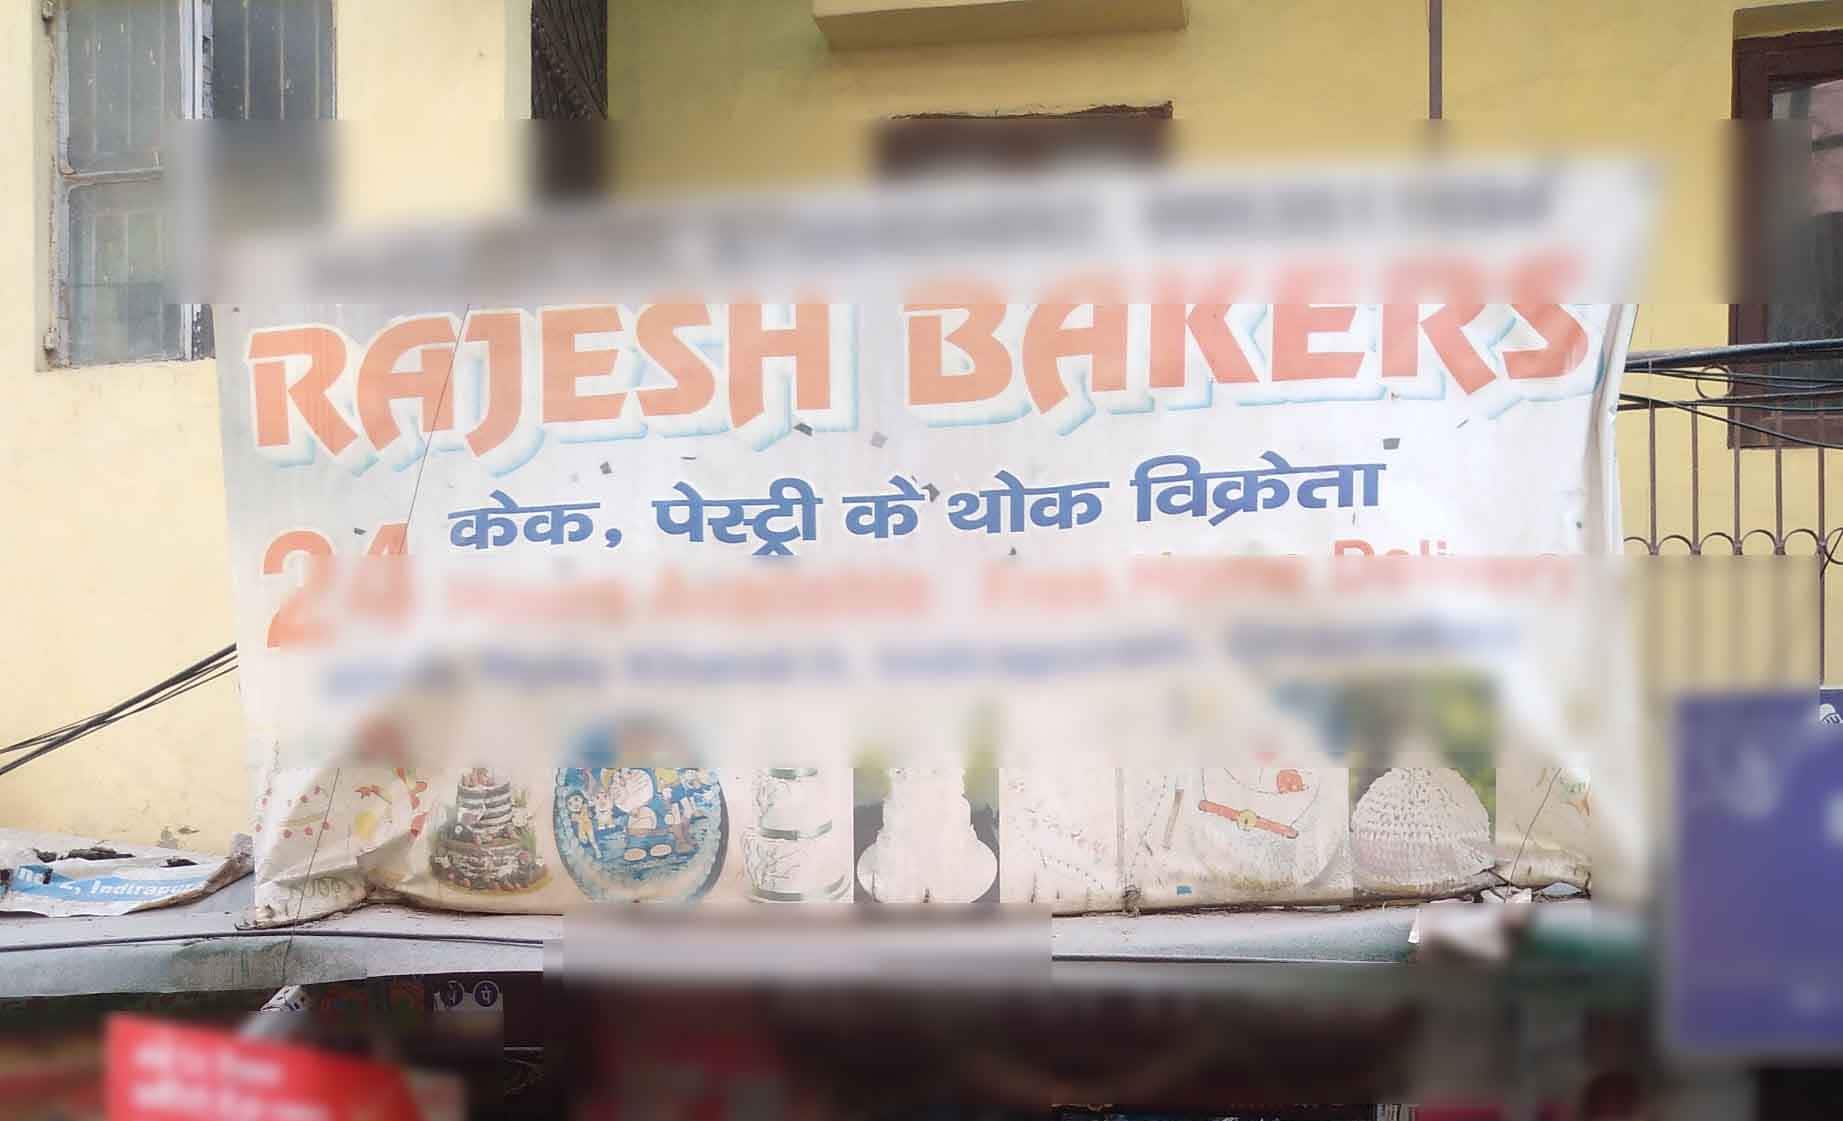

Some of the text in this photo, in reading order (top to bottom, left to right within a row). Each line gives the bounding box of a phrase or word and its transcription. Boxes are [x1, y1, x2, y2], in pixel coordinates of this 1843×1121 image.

[246, 254, 1594, 460] RAJESH BAKERS
[448, 451, 1387, 556] केक, पेस्ट्री के थोक विक्रेता
